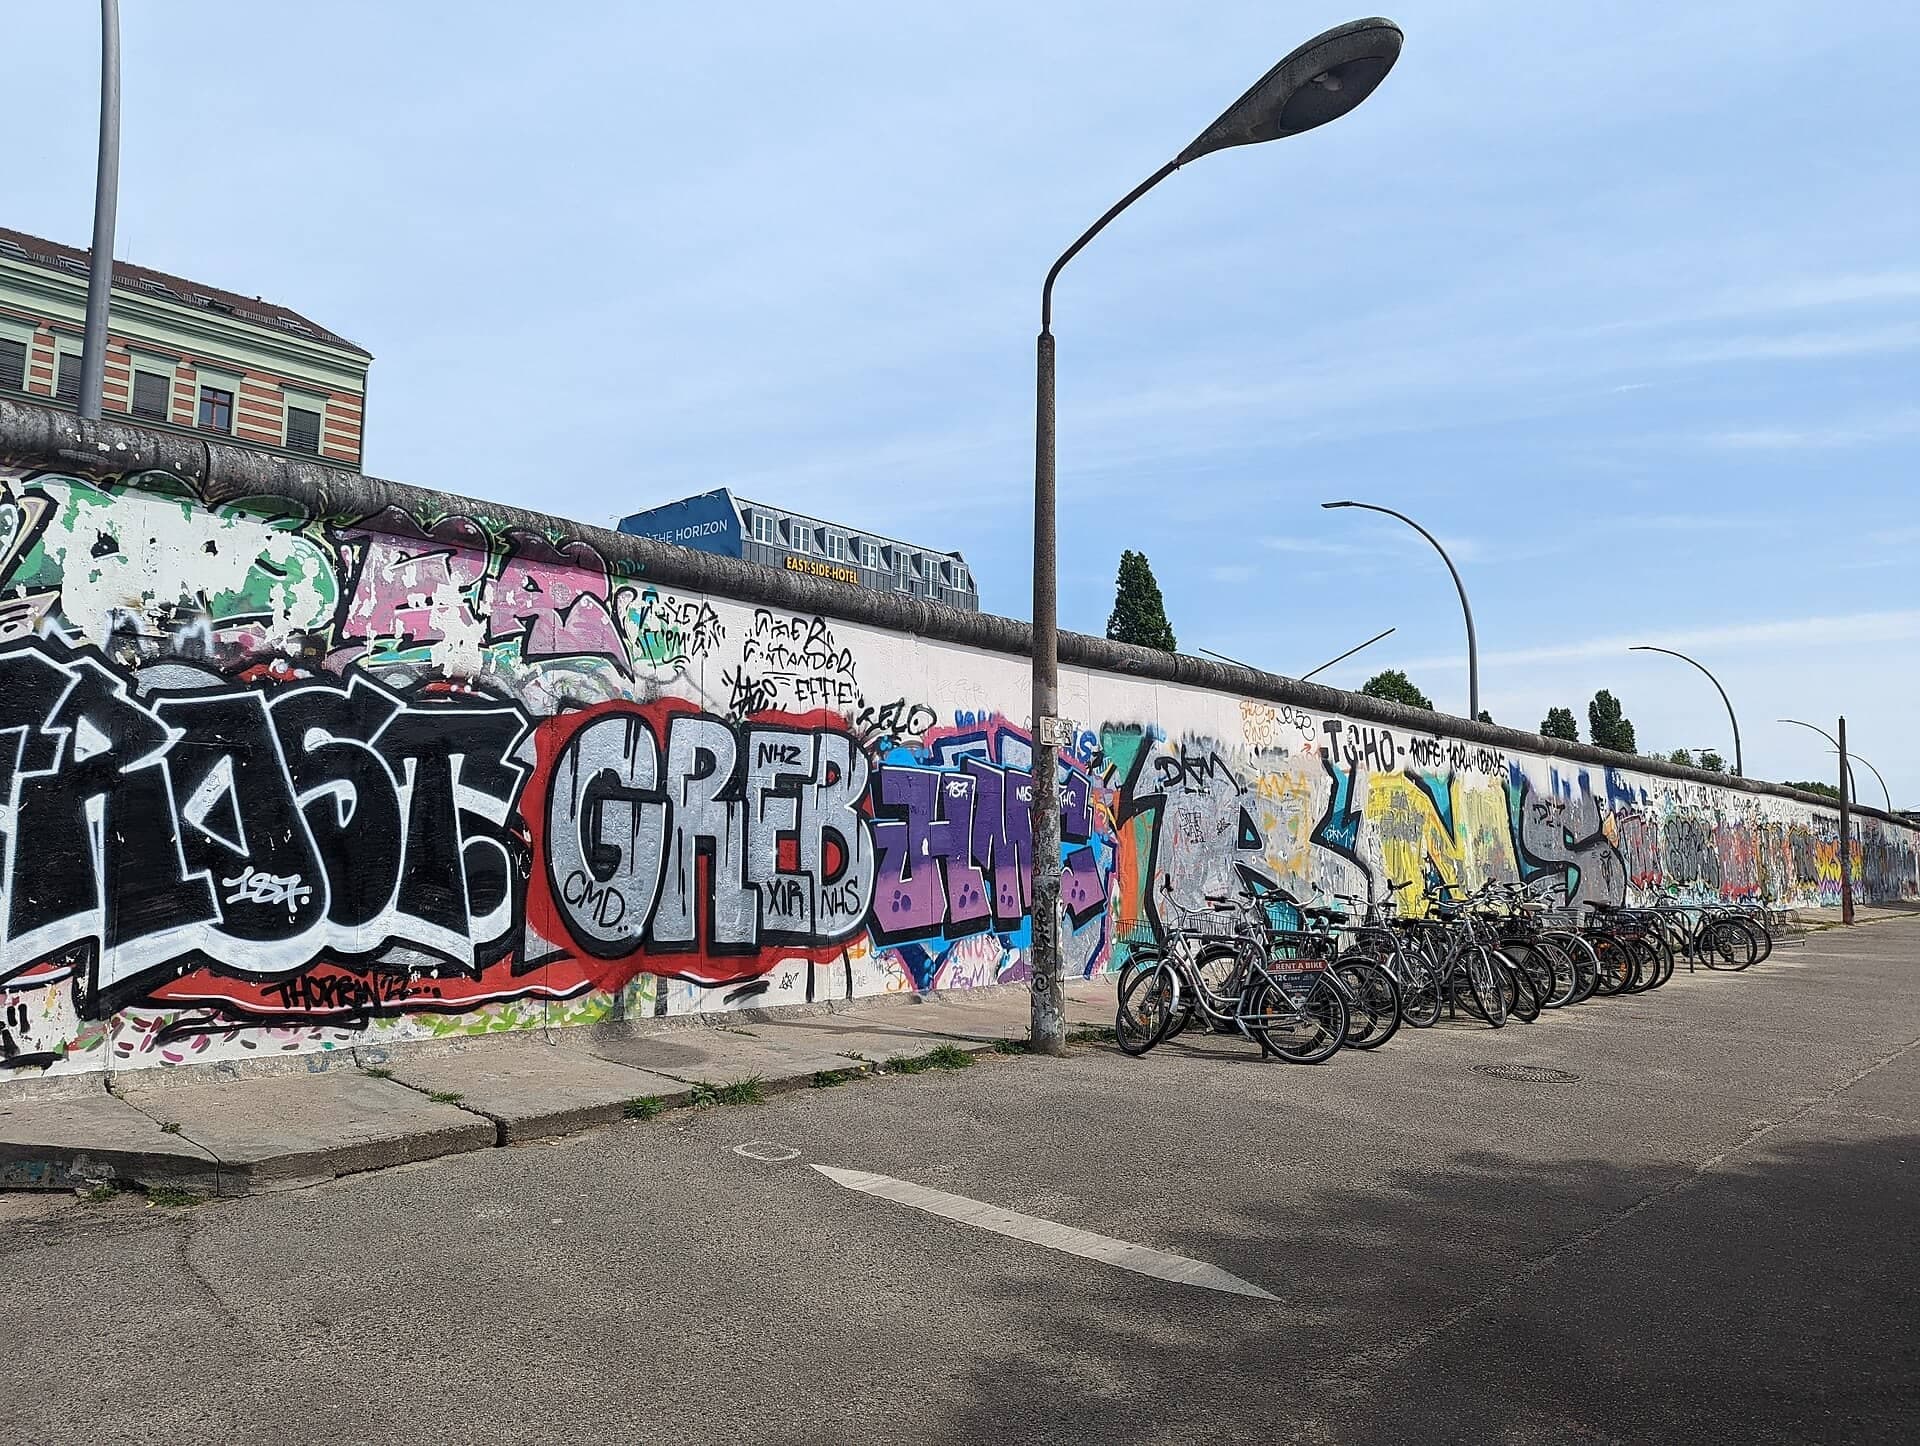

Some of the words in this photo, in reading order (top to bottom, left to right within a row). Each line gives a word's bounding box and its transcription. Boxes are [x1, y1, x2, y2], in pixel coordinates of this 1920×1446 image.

[676, 519, 728, 541] HORIZON
[546, 707, 877, 958] GREB
[1275, 962, 1296, 970] RENT
[1305, 961, 1324, 969] BIKE
